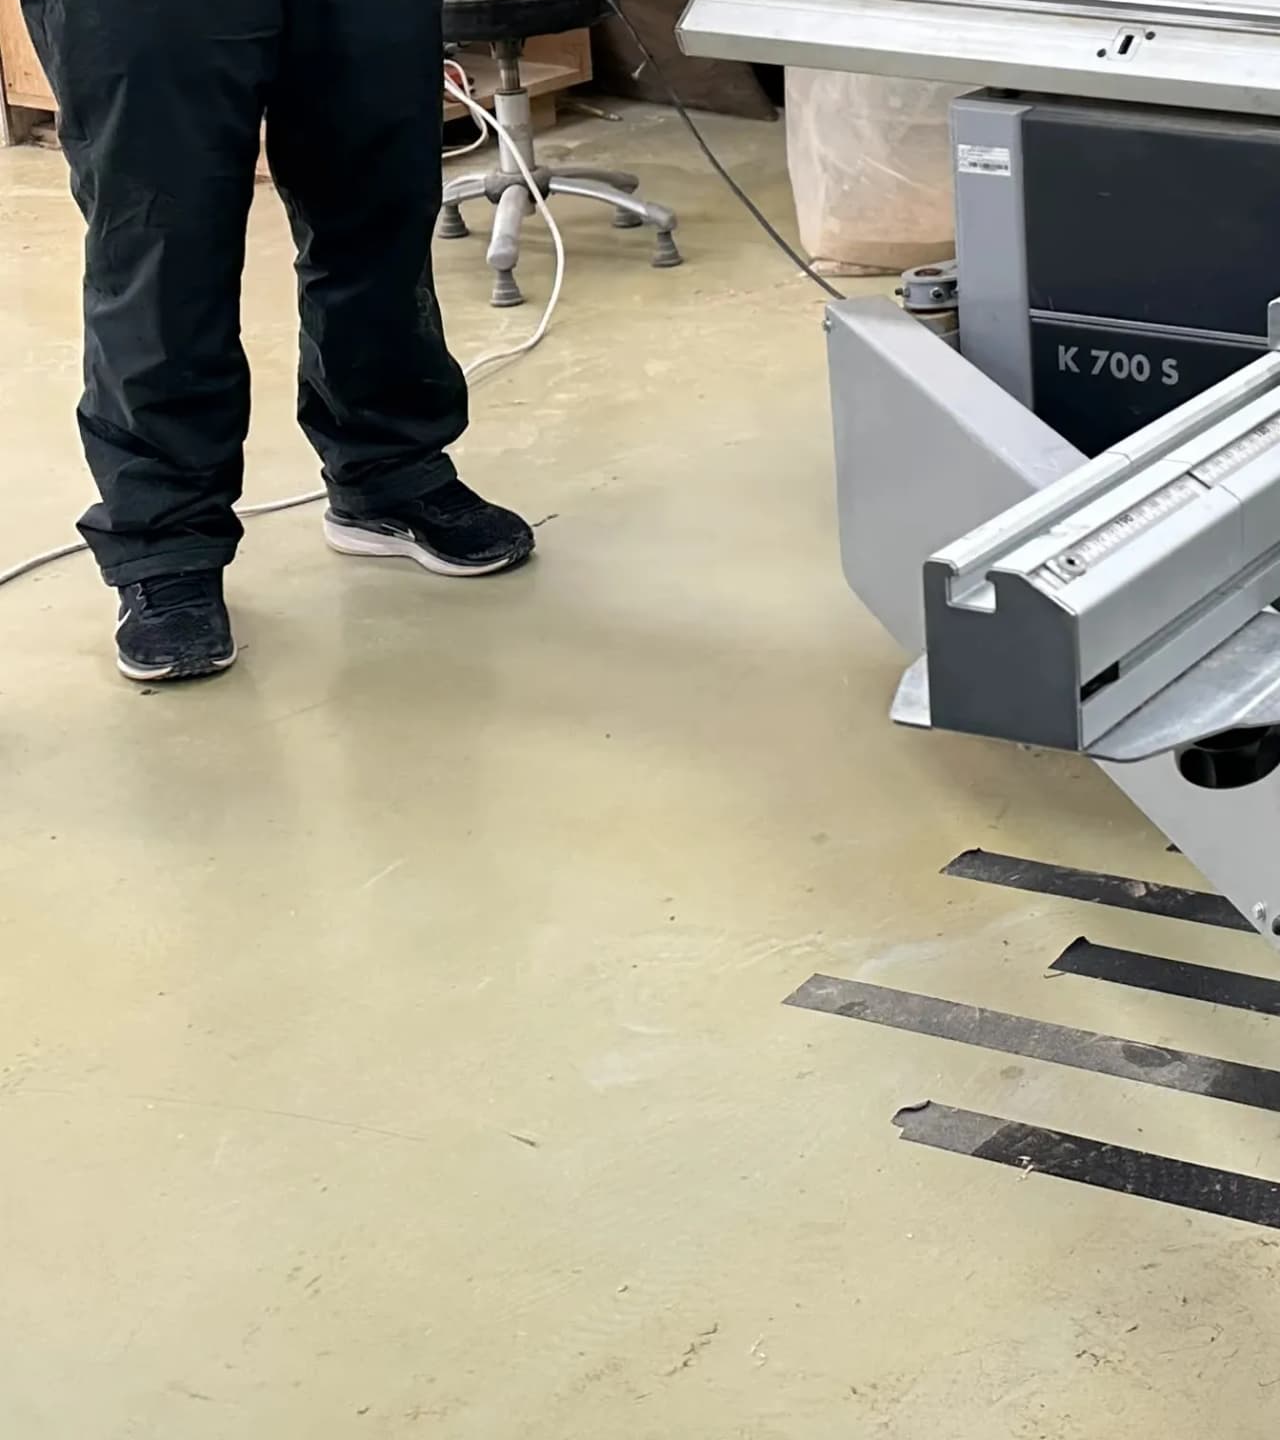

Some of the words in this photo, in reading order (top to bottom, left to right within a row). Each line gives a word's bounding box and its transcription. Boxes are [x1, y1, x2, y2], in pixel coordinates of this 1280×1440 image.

[1057, 345, 1081, 373] K
[1090, 349, 1151, 383] 700
[1161, 358, 1180, 386] S
